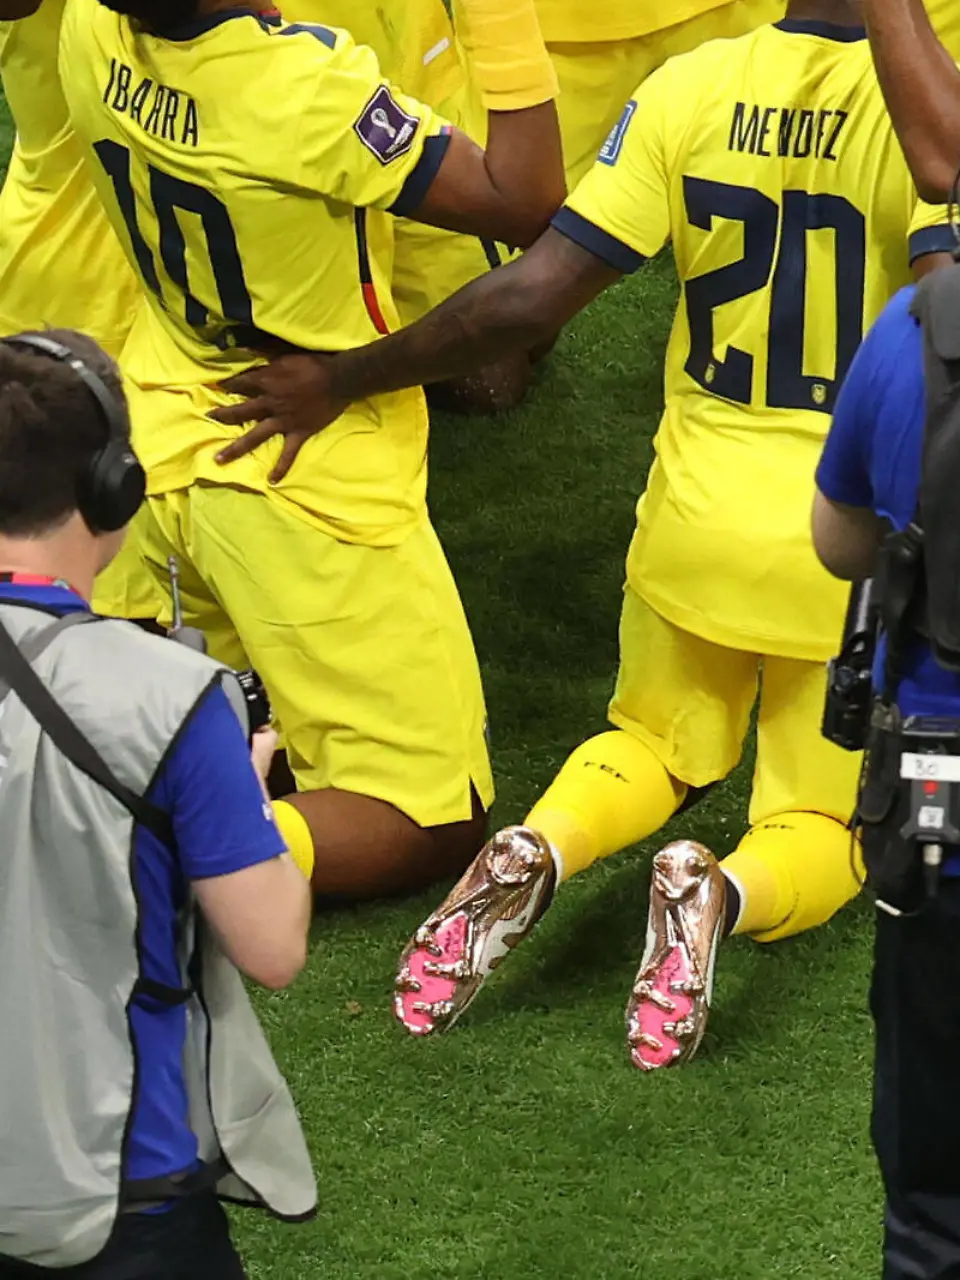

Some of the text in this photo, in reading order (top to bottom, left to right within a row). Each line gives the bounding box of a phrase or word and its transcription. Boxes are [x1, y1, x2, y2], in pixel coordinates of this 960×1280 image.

[103, 58, 199, 148] IBARRA
[728, 101, 849, 161] MENDEZ
[92, 138, 260, 351] 10
[682, 174, 866, 416] 20
